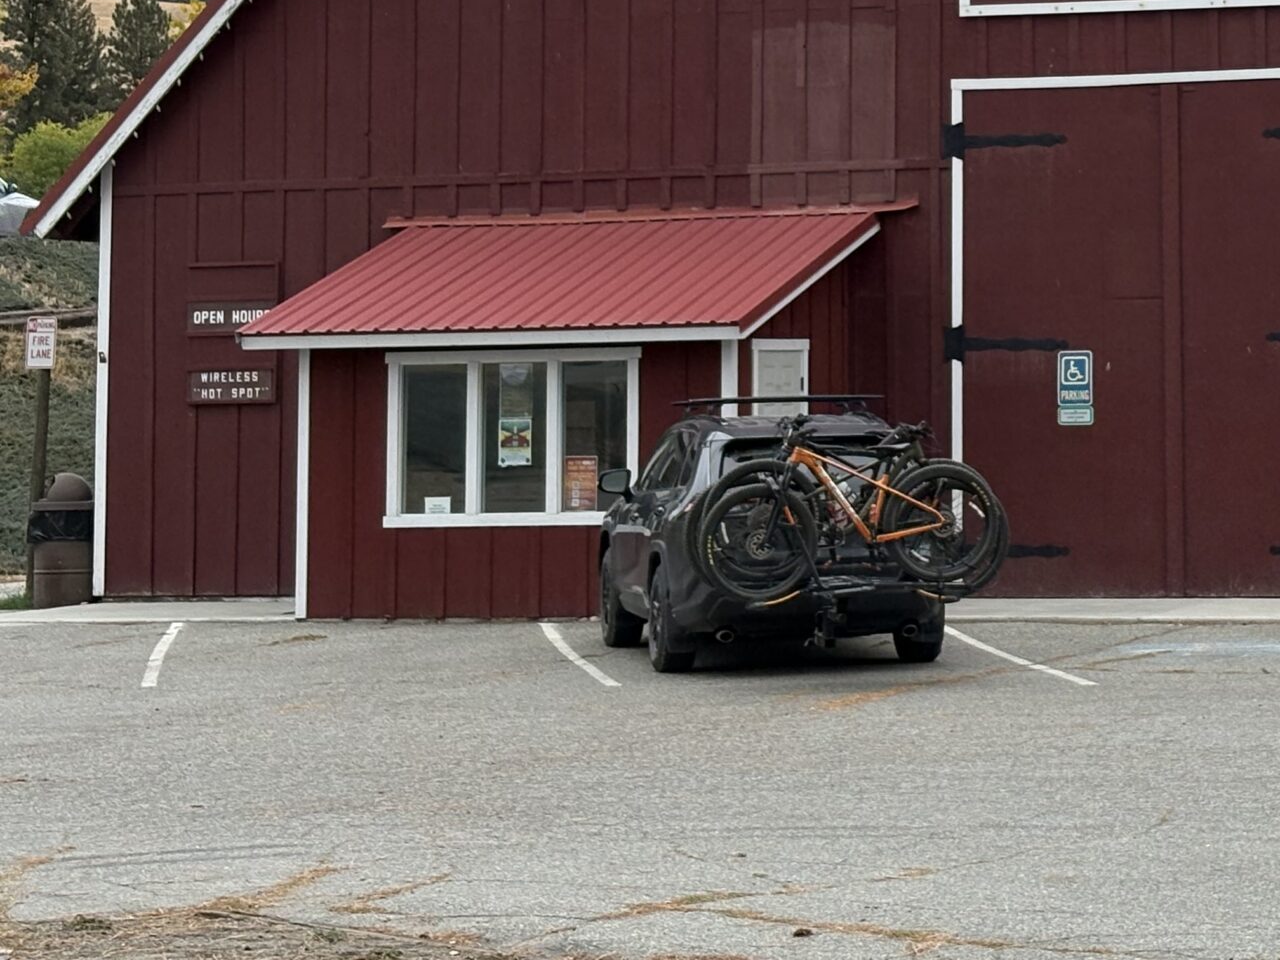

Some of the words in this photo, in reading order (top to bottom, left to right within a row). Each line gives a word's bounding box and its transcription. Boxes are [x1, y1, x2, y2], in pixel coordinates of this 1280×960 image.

[193, 310, 225, 325] OPEN
[32, 335, 50, 346] FIRE
[30, 349, 52, 359] LANE
[200, 371, 259, 383] WIRELESS
